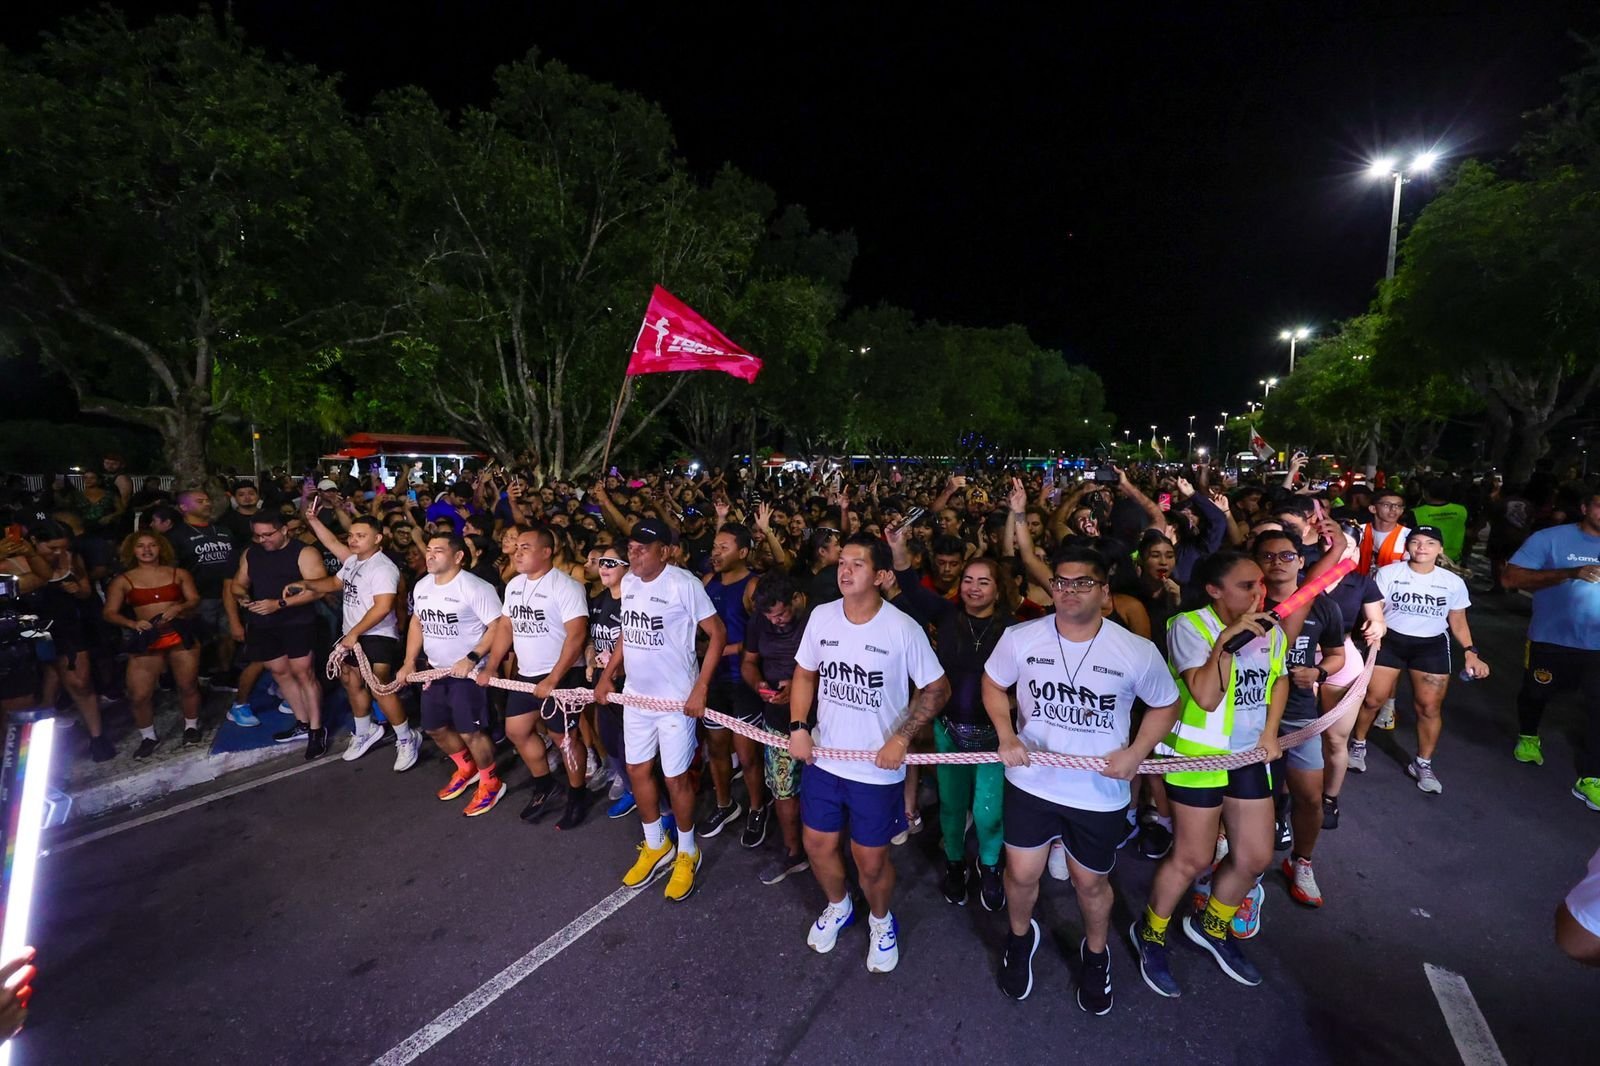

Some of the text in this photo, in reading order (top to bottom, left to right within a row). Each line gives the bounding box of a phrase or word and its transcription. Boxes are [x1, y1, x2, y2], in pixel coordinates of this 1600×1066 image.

[1391, 592, 1447, 606] CORRE
[623, 610, 664, 631] ORRE
[818, 660, 884, 689] CORRE
[829, 681, 882, 708] QUINTA
[1029, 679, 1117, 711] CORRE
[1044, 702, 1115, 730] QUINTA
[1067, 726, 1096, 734] EXPERIENCE
